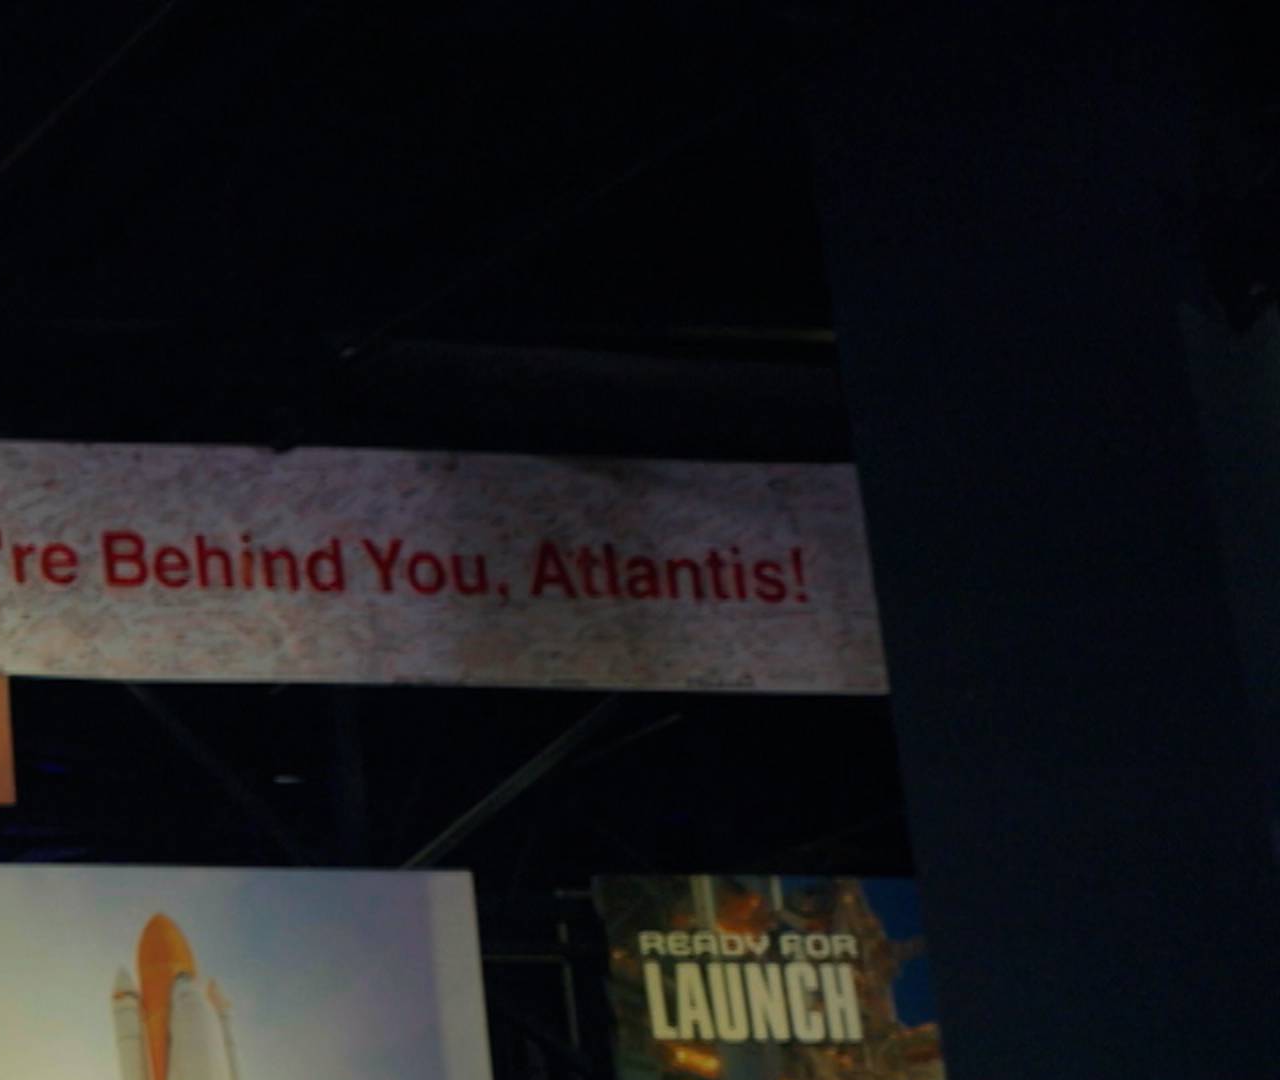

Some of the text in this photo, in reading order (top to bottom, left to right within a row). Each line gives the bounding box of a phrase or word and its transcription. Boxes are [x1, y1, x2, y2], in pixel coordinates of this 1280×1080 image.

[101, 530, 347, 593] Behind
[364, 540, 510, 602] You,
[530, 542, 808, 603] Atlantis!
[638, 929, 859, 959] READY FOR
[642, 961, 864, 1043] LAUNCH
